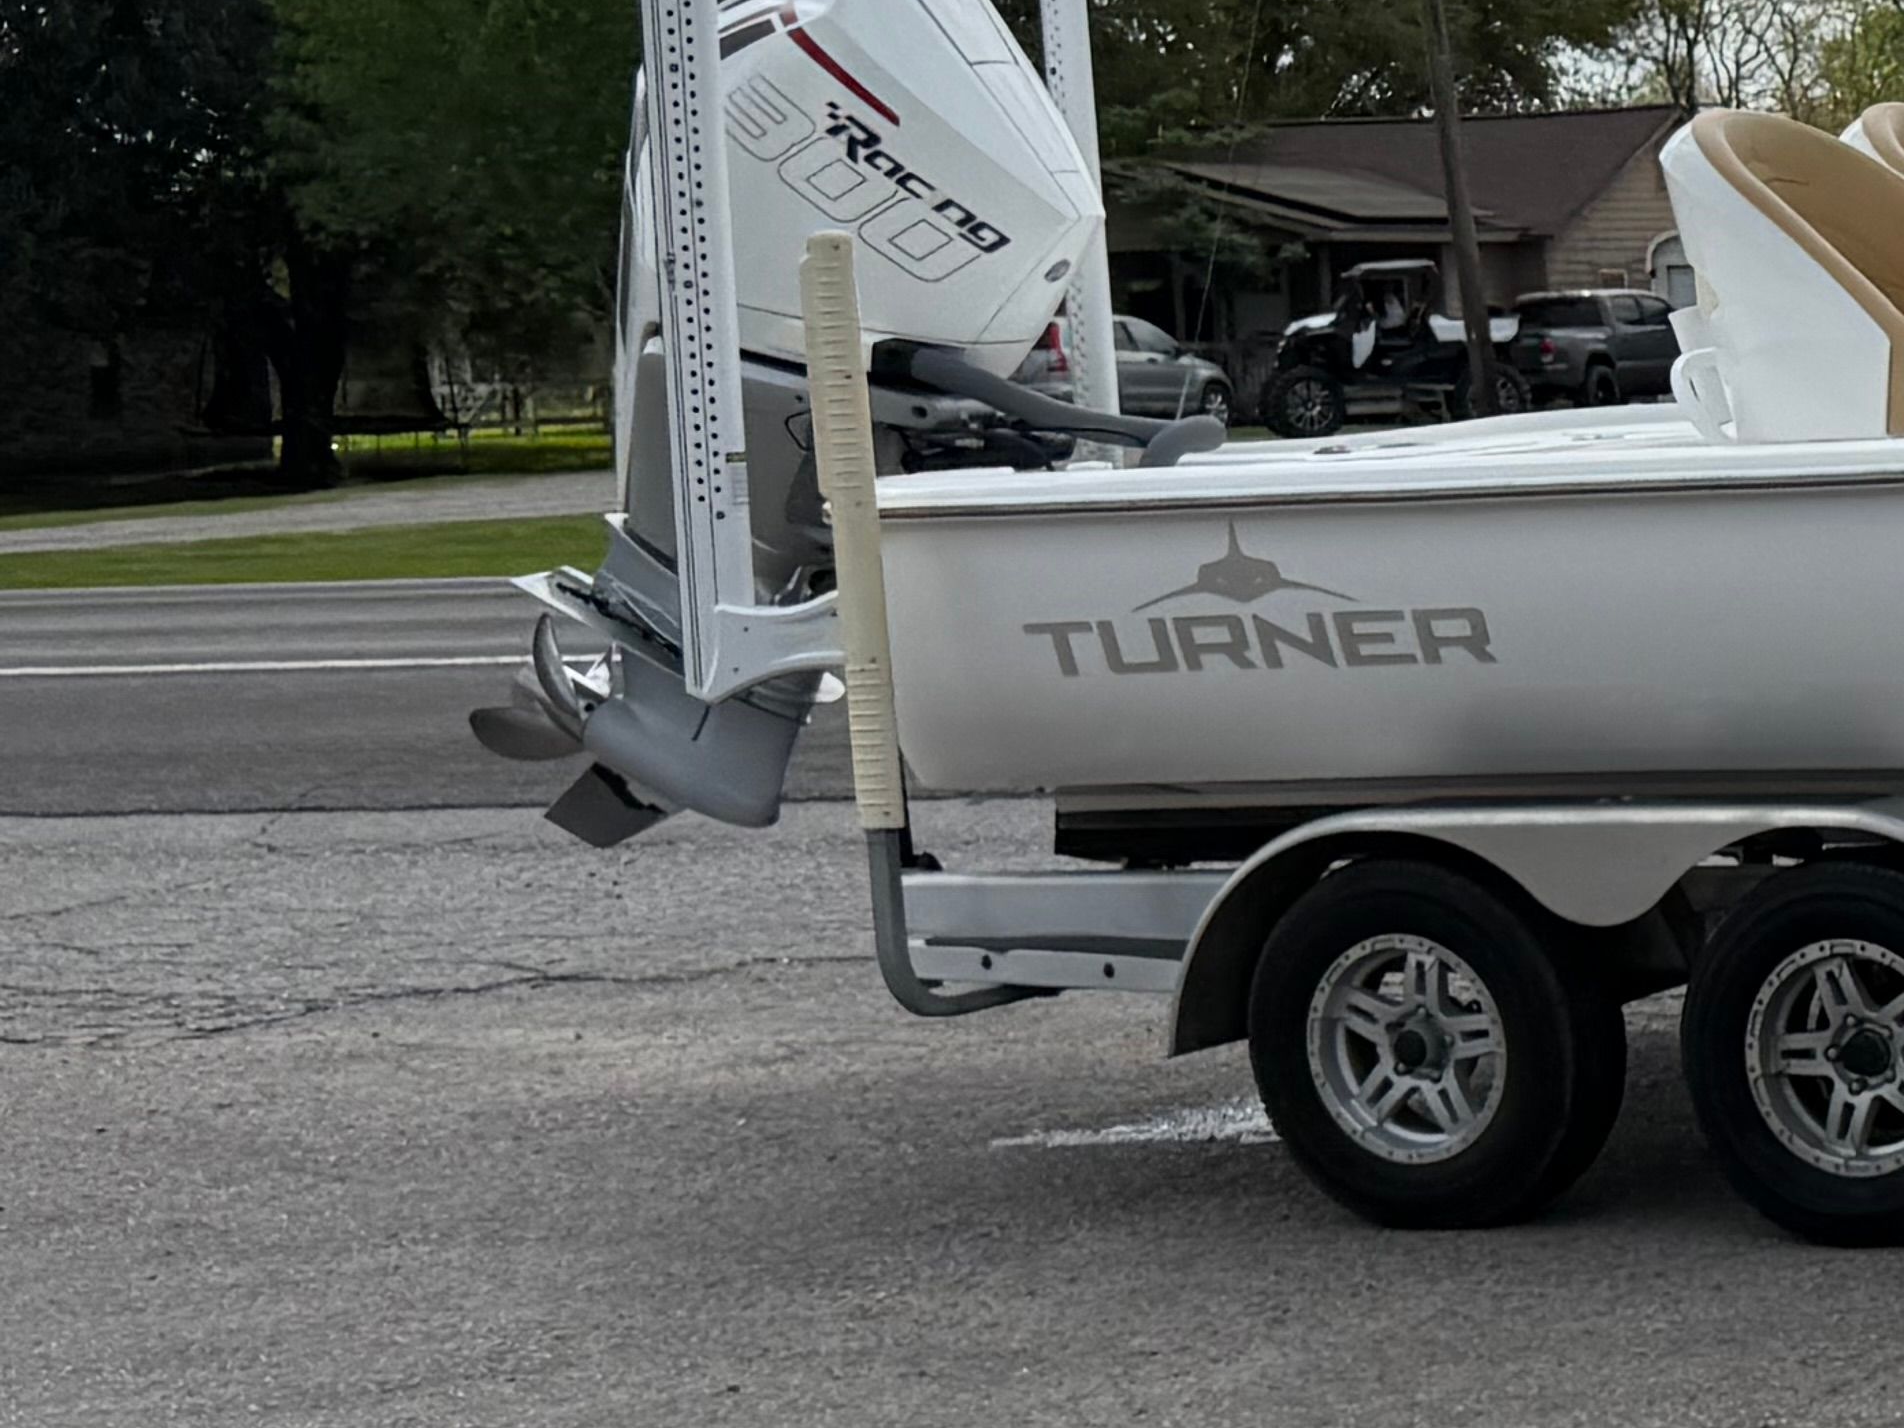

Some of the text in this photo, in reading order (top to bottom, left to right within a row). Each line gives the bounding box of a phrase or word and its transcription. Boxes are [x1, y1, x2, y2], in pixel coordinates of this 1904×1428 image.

[725, 74, 982, 283] 300
[826, 102, 1011, 254] Racng
[1023, 607, 1497, 678] TURNER
